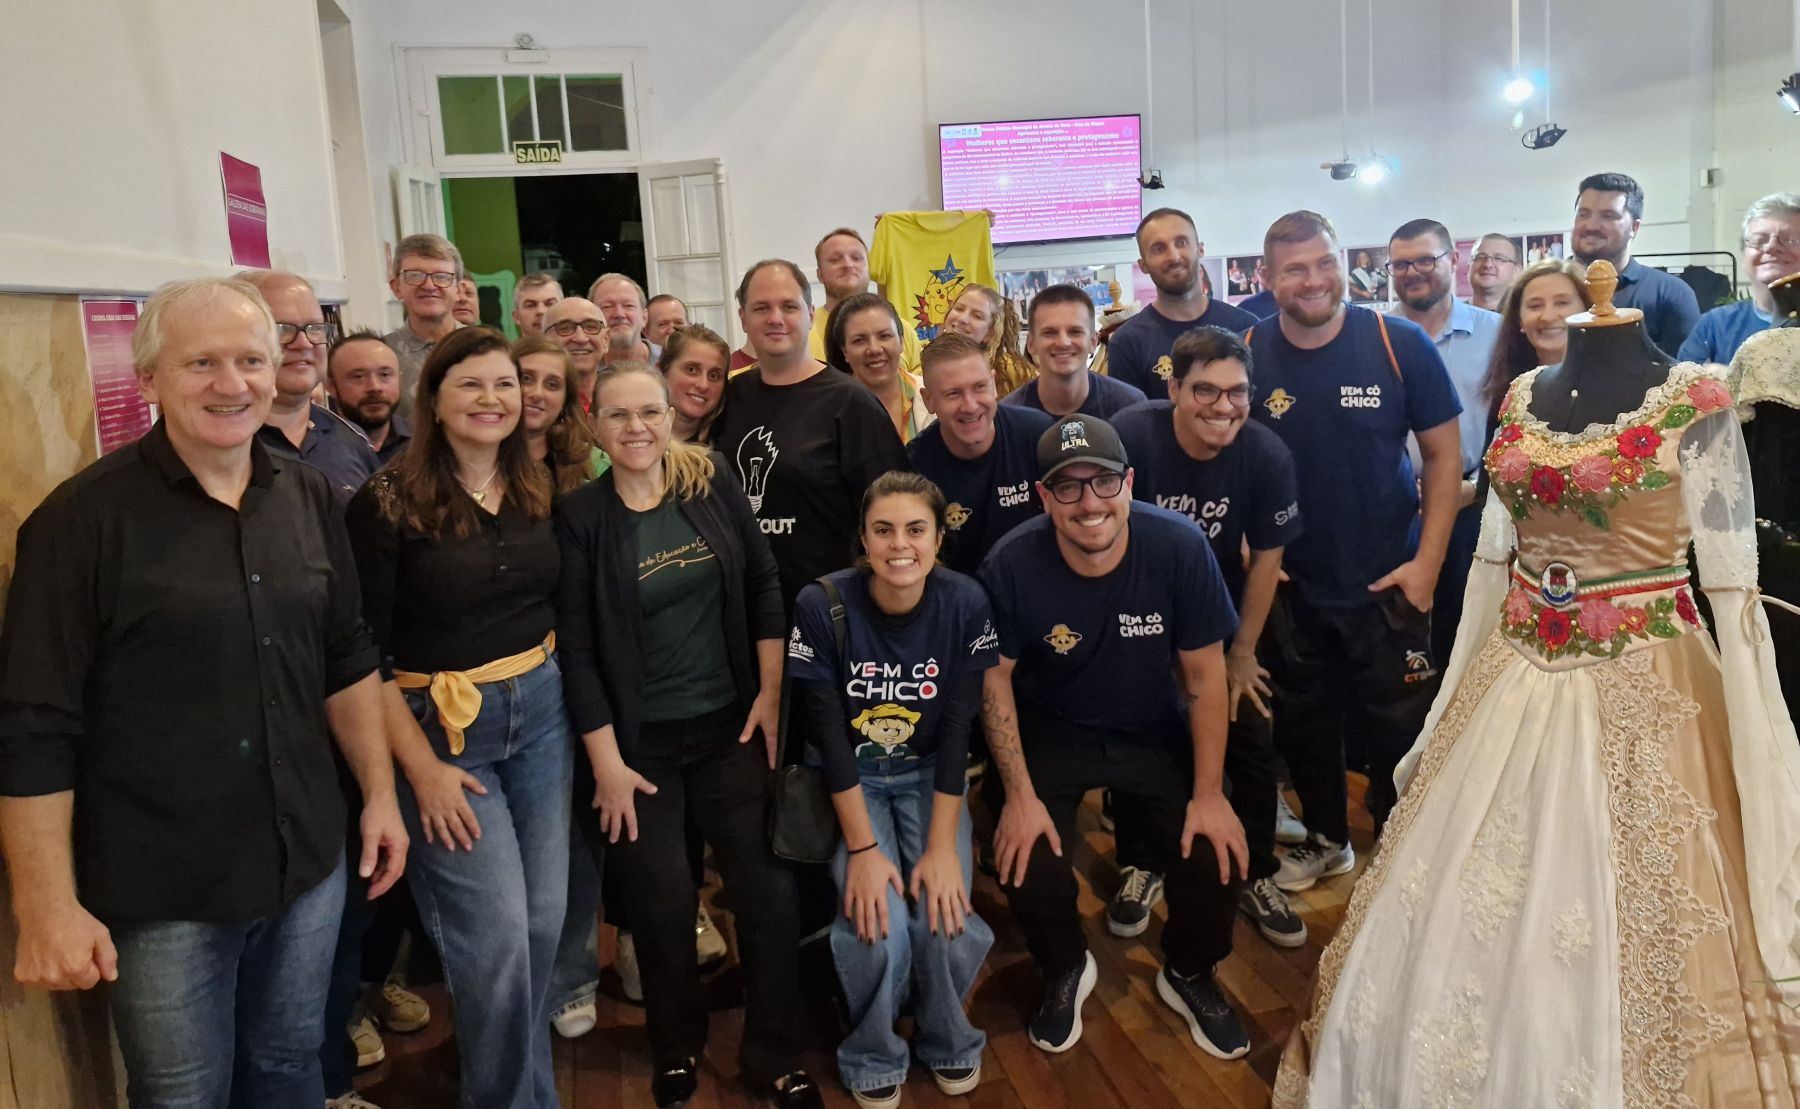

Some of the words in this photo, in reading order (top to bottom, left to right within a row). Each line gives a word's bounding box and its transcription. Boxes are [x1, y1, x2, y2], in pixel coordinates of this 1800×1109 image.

[995, 139, 1008, 147] que
[517, 143, 560, 163] SAÍDA
[1340, 386, 1363, 396] VEM
[1366, 384, 1381, 396] CÔ
[1340, 396, 1381, 408] CHICO
[1061, 438, 1089, 451] ULTRA
[997, 485, 1016, 496] VEM
[999, 491, 1029, 507] CHICO
[1156, 493, 1197, 512] VEM
[1202, 497, 1230, 518] CÔ
[756, 517, 796, 535] OUT
[1118, 613, 1142, 626] VEM
[1145, 612, 1163, 624] CÔ
[1120, 623, 1164, 637] CHICO
[788, 639, 814, 654] ictos
[849, 661, 901, 678] VEM
[912, 658, 940, 679] CÔ
[846, 679, 938, 700] CHICO
